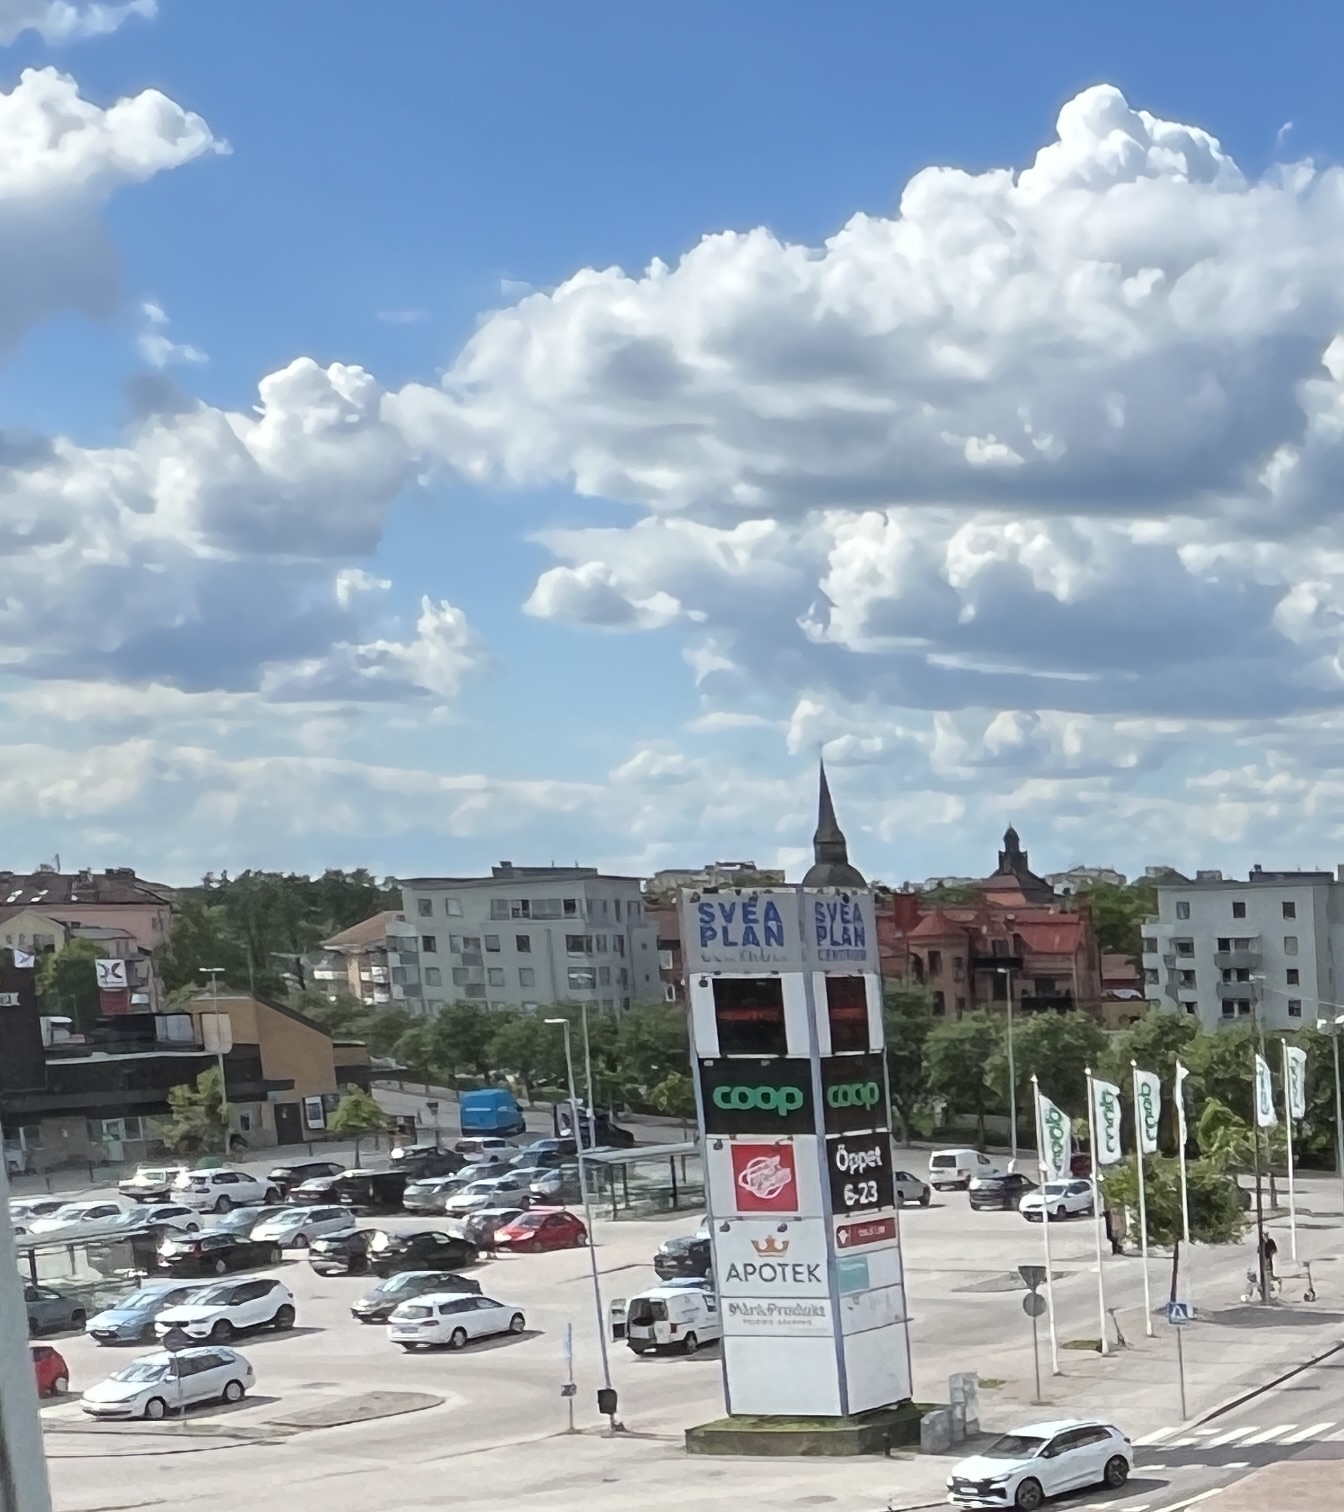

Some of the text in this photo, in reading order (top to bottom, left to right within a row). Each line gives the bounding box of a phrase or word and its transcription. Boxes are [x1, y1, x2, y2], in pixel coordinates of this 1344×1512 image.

[698, 901, 782, 924] SVEA
[814, 901, 863, 924] SVEA
[700, 924, 784, 947] PLAN
[815, 924, 865, 947] PLAN
[713, 1085, 803, 1117] coop
[827, 1081, 880, 1111] coop
[844, 1180, 878, 1206] 6-23
[726, 1262, 822, 1283] APOTEK
